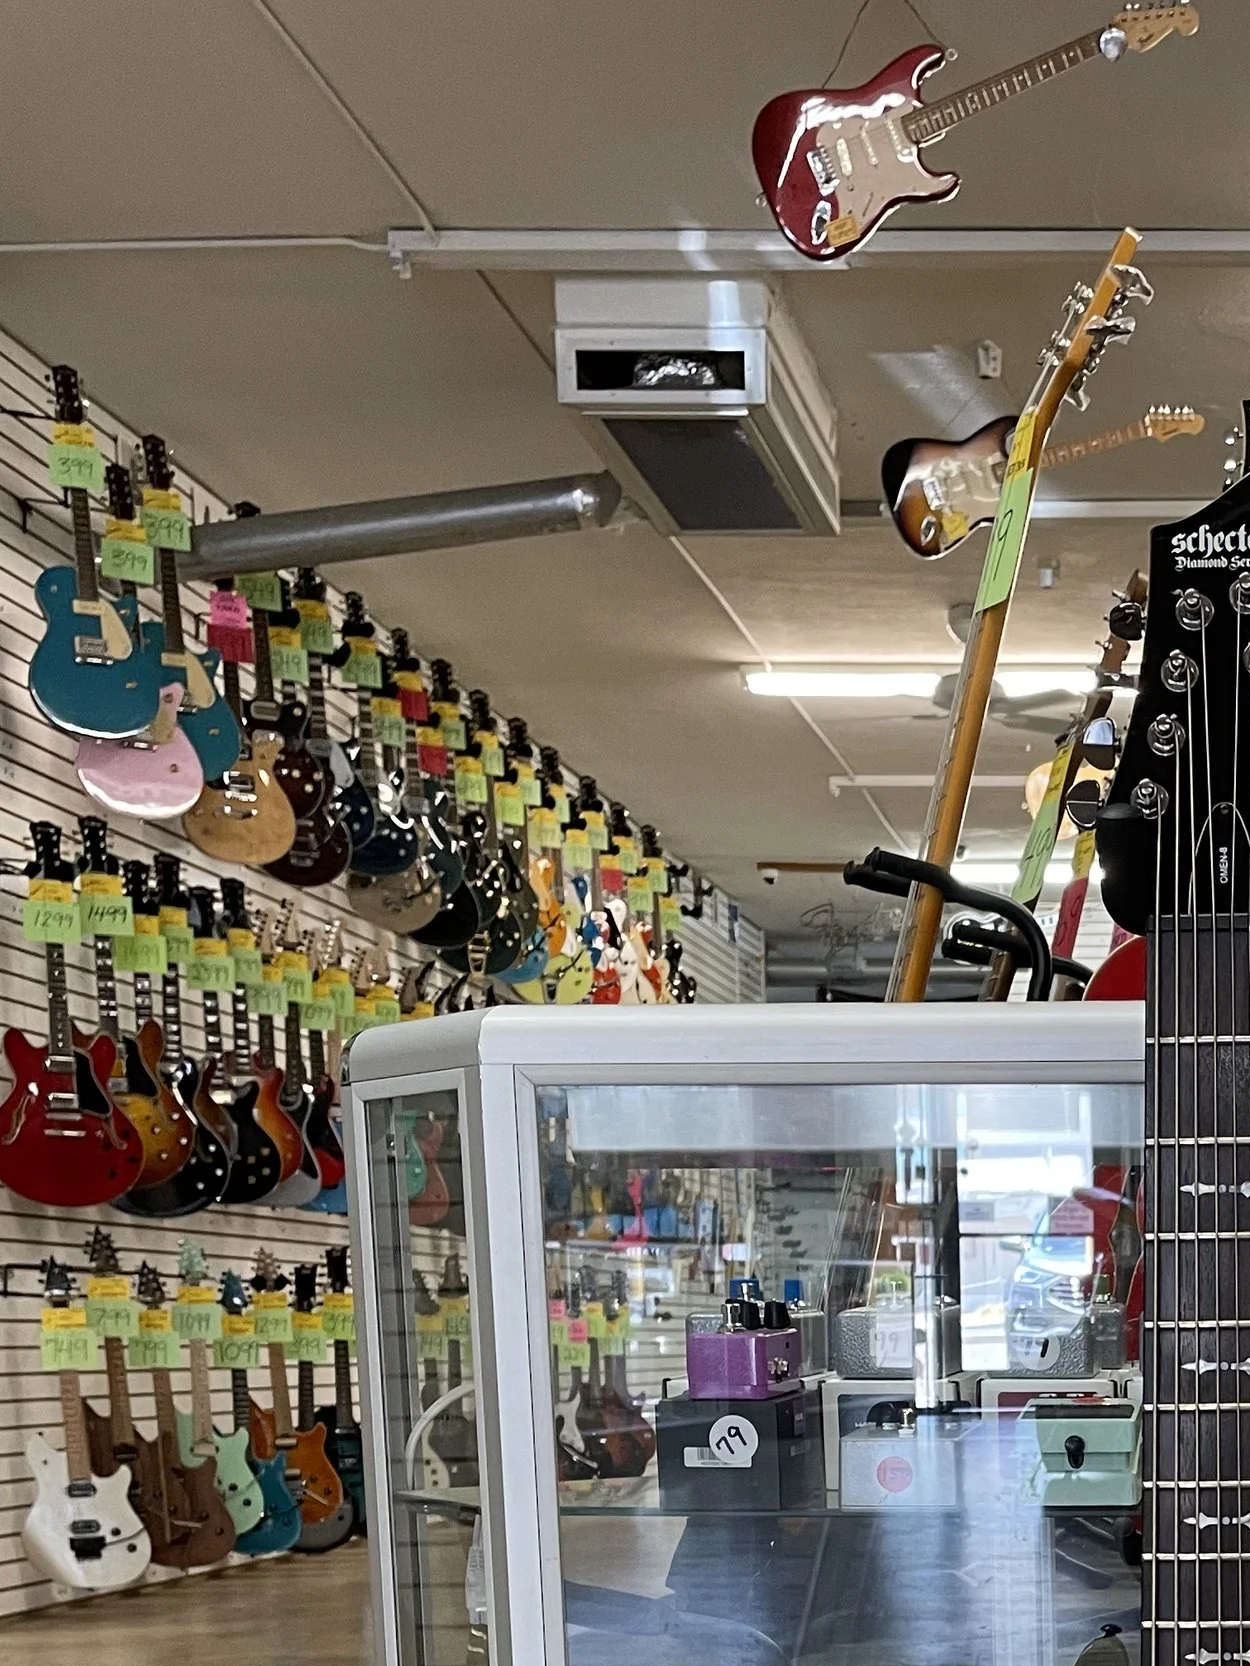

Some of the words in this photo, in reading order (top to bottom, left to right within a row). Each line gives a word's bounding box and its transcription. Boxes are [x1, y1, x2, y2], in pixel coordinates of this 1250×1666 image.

[57, 457, 94, 477] 399
[110, 552, 149, 571] 399
[1175, 555, 1228, 571] Diamond
[1219, 846, 1229, 884] OMEN-8
[34, 909, 74, 929] 1299
[88, 904, 128, 924] 1499
[715, 1425, 748, 1455] 79
